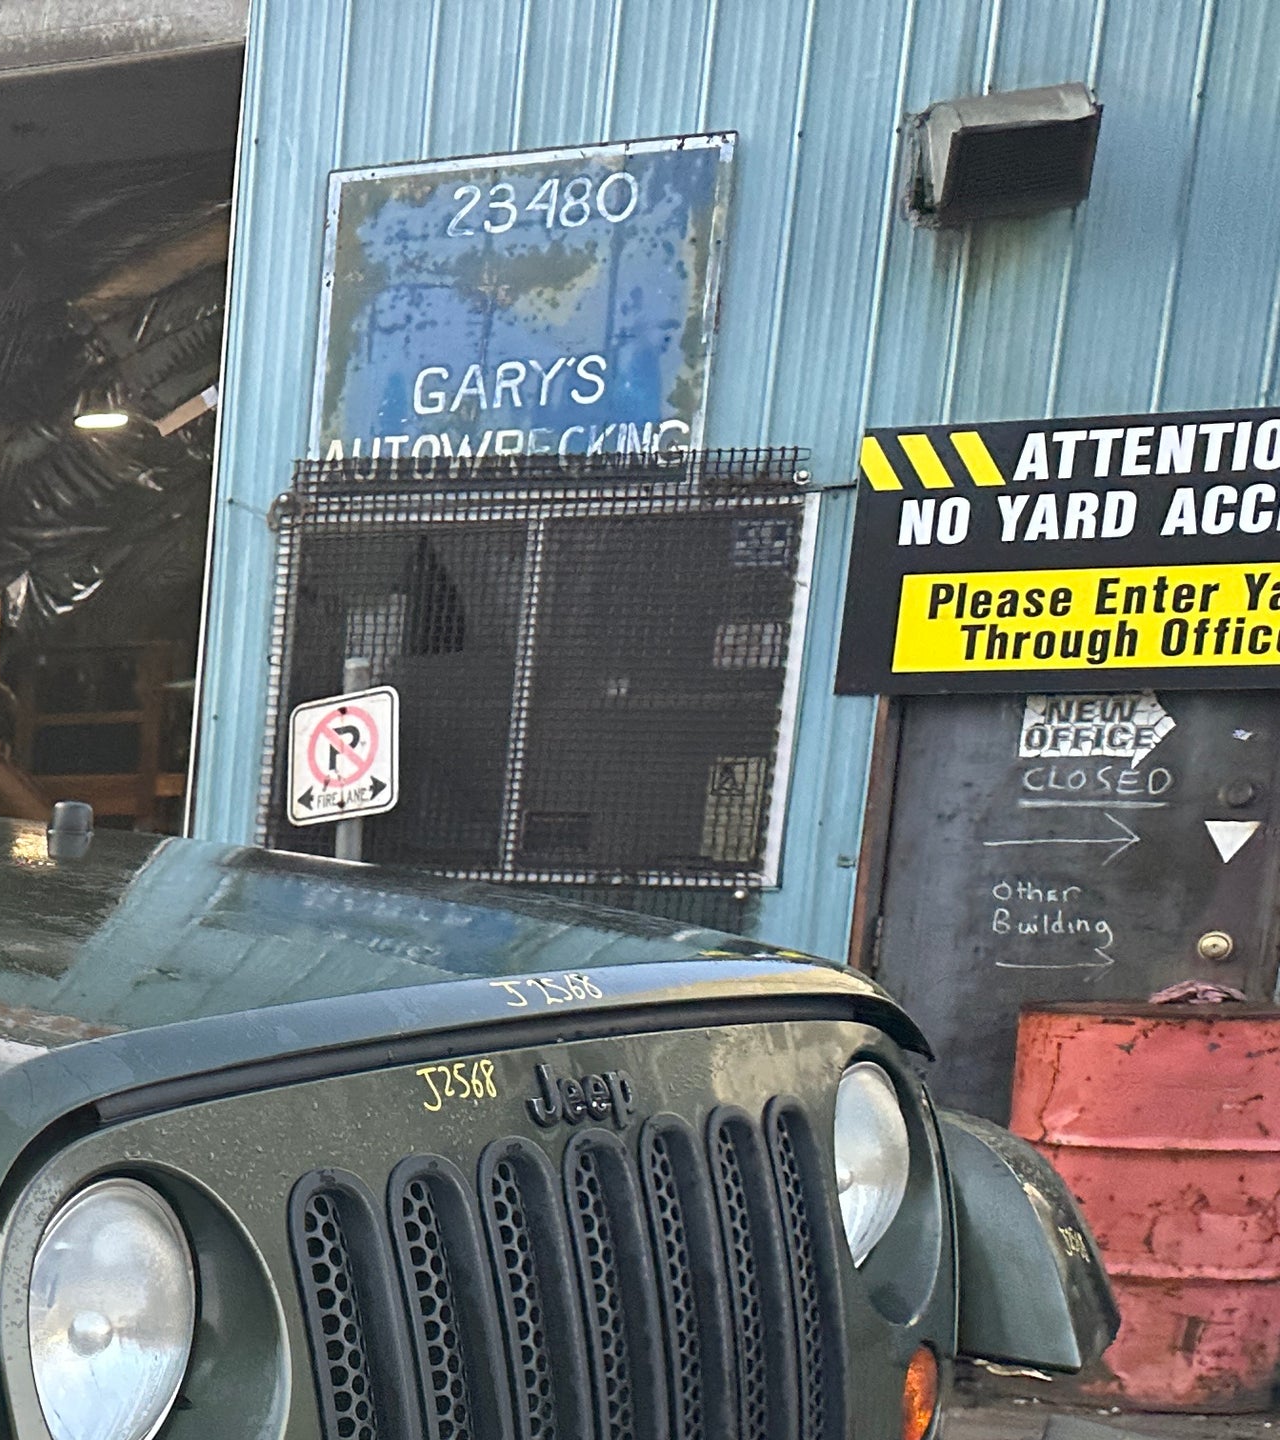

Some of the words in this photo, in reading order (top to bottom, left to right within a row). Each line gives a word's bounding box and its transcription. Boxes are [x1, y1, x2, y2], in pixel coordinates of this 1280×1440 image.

[446, 171, 639, 238] 23480
[412, 354, 607, 415] GARY'S
[1012, 418, 1280, 482] ATTENTIO
[898, 496, 971, 546] NO
[997, 490, 1137, 542] YARD
[1160, 483, 1280, 536] ACC
[928, 582, 1072, 619] Please
[1095, 577, 1219, 614] Enter
[960, 619, 1138, 664] Through
[1160, 617, 1280, 656] Offic
[1044, 698, 1137, 723] NEW
[1024, 725, 1157, 750] OFFICE
[1022, 765, 1172, 796] CLOSED
[992, 881, 1081, 903] Other
[992, 908, 1114, 949] Building
[490, 973, 602, 1008] J2568
[416, 1059, 497, 1112] J2568
[525, 1062, 636, 1130] Jeep
